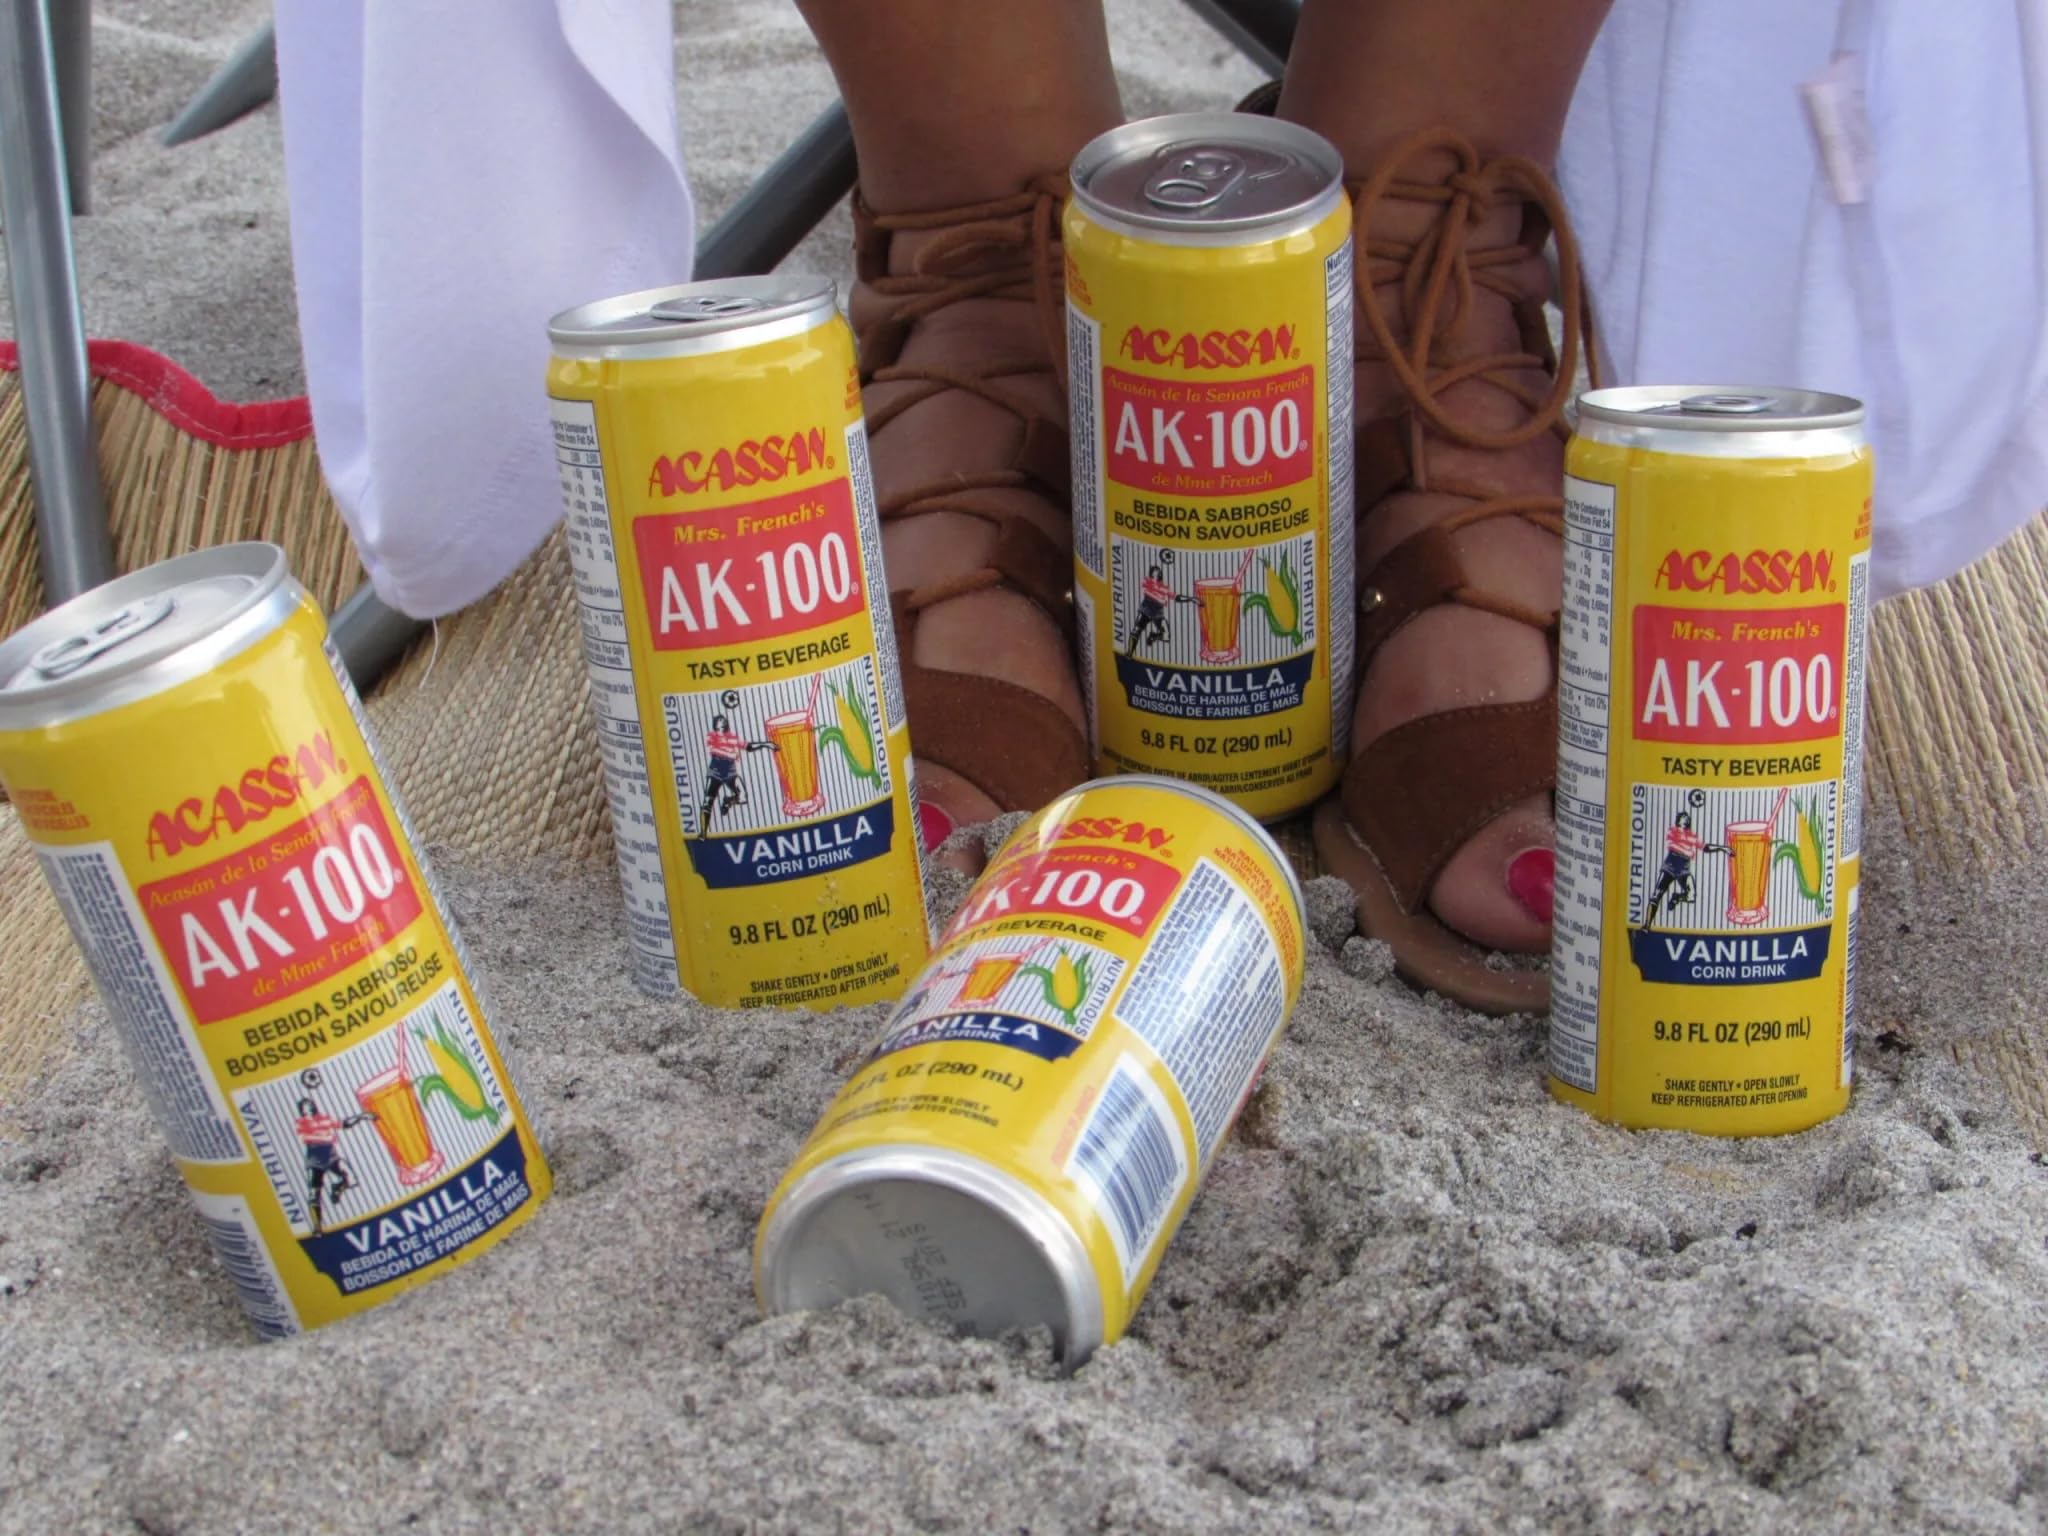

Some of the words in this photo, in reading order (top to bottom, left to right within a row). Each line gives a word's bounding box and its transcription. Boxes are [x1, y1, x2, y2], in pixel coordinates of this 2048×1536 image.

[1266, 372, 1310, 394] French
[1152, 472, 1169, 486] de
[1175, 474, 1216, 489] Mme
[1220, 471, 1273, 489] French
[673, 523, 727, 547] Mrs.
[735, 502, 826, 538] French's
[1114, 511, 1191, 540] BOISSON
[1196, 508, 1310, 541] SAVOUREUSE
[1133, 499, 1200, 522] BEBIDA
[1206, 497, 1292, 522] SABROSO
[1113, 544, 1124, 643] NUTRITIVA
[1301, 539, 1314, 642] NUTRITIVE
[1671, 620, 1721, 642] Mrs.
[1731, 619, 1822, 642] French's
[687, 655, 750, 682] TASTY
[757, 632, 851, 672] BEVERAGE
[1134, 685, 1176, 704] BEBIDA
[1180, 694, 1196, 705] DE
[1200, 693, 1248, 706] HARINA
[1251, 688, 1268, 701] DE
[1146, 668, 1285, 694] VANILLA
[862, 655, 892, 794] NUTRITIOUS
[1132, 696, 1183, 716] BOISSON
[1186, 706, 1203, 717] DE
[1207, 704, 1251, 718] FARINE
[1254, 701, 1270, 713] DE
[1140, 729, 1165, 749] 9.8
[1169, 735, 1190, 753] FL
[1194, 736, 1217, 754] OZ
[1222, 735, 1260, 758] (290
[1264, 727, 1292, 749] mL)
[663, 694, 697, 834] NUTRITIOUS
[1661, 756, 1723, 776] TASTY
[1728, 753, 1822, 777] BEVERAGE
[723, 814, 875, 866] VANILLA
[1628, 785, 1645, 925] NUTRITIOUS
[1824, 780, 1837, 920] NUTRITIOUS
[220, 864, 246, 886] de
[247, 855, 269, 874] la
[756, 858, 804, 879] CORN
[807, 846, 853, 871] DRINK
[729, 924, 759, 946] 9.8
[764, 919, 788, 943] FL
[792, 914, 817, 937] OZ
[822, 904, 859, 936] (290
[863, 892, 891, 921] mL)
[997, 919, 1107, 942] BEVERAGE
[251, 977, 278, 998] de
[279, 955, 327, 986] Mme
[329, 919, 386, 964] French
[1664, 935, 1809, 963] VANILLA
[751, 977, 783, 993] SHAKE
[784, 972, 821, 989] GENTLY
[830, 964, 855, 980] OPEN
[856, 951, 889, 973] SLOWLY
[765, 985, 838, 1007] REFRIGERATED
[839, 976, 867, 994] AFTER
[867, 963, 901, 986] OPENING
[1691, 964, 1737, 980] CORN
[1740, 963, 1787, 979] DRINK
[225, 1026, 328, 1077] BOISSON
[329, 951, 444, 1039] SAVOUREUSE
[242, 1001, 330, 1048] BEBIDA
[330, 945, 418, 1011] SABROSO
[1074, 956, 1125, 1037] NUTRITIOUS
[449, 988, 508, 1112] NUTRITIVE
[943, 1030, 1004, 1042] DRINK
[1654, 1020, 1683, 1041] 9.8
[1687, 1022, 1710, 1043] FL
[1715, 1022, 1739, 1044] OZ
[1745, 1020, 1782, 1047] (290
[1785, 1015, 1811, 1041] mL)
[928, 1061, 978, 1077] (290
[981, 1067, 1024, 1092] mL)
[1651, 1092, 1675, 1106] KEEP
[1677, 1094, 1748, 1108] REFRIGERATED
[1750, 1092, 1776, 1106] AFTER
[1777, 1087, 1808, 1103] OPENING
[1664, 1078, 1697, 1093] SHAKE
[1698, 1079, 1735, 1094] GENTLY
[1743, 1078, 1768, 1092] OPEN
[1769, 1074, 1801, 1090] SLOWLY
[239, 1100, 304, 1225] NUTRITIVA
[344, 1159, 504, 1254] VANILLA
[340, 1244, 399, 1276] BEBIDA
[399, 1234, 422, 1252] DE
[422, 1209, 477, 1244] HARINA
[475, 1193, 495, 1213] DE
[343, 1256, 413, 1291] BOISSON
[413, 1248, 436, 1267] DE
[435, 1216, 486, 1256] FARINE
[485, 1205, 504, 1226] DE
